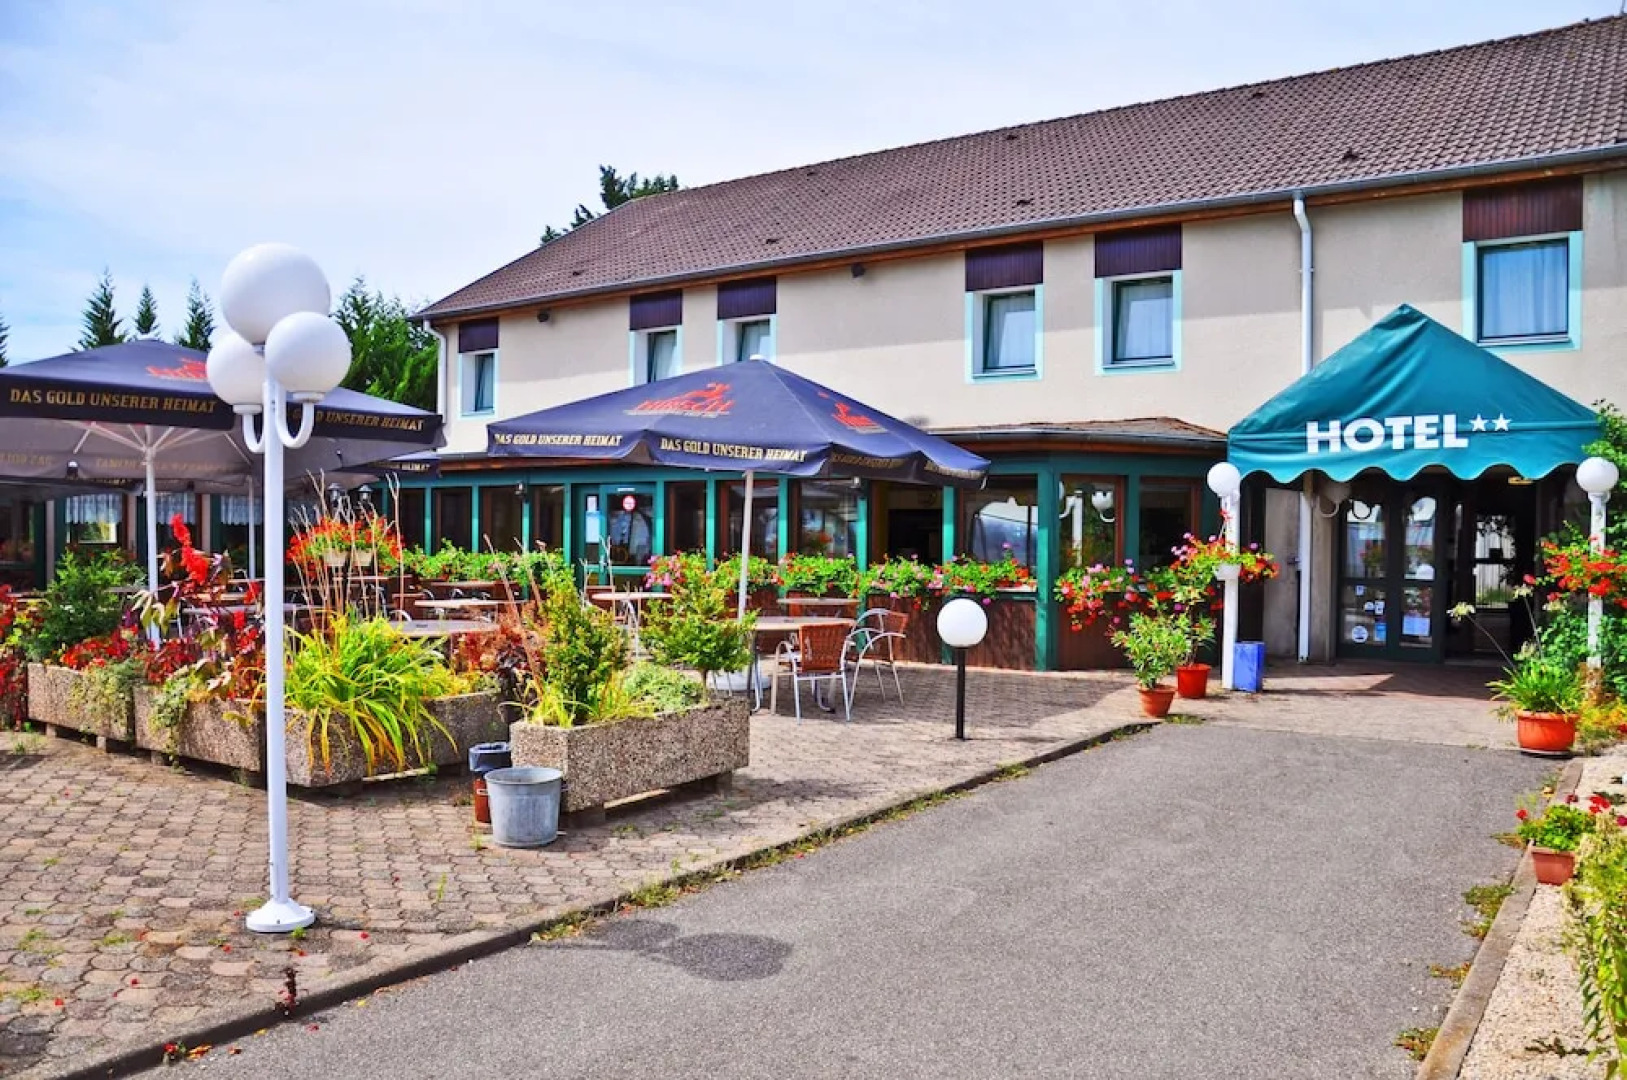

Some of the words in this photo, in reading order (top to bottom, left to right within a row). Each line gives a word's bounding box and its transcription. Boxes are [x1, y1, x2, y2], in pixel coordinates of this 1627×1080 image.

[10, 388, 42, 403] DAS
[46, 389, 86, 406] GOLD
[90, 393, 159, 410] UNSERER
[161, 397, 217, 413] HEIMAT
[513, 434, 538, 445] GOLD
[538, 434, 582, 445] UNSERER
[583, 435, 623, 446] HEIMAT
[1306, 414, 1468, 455] HOTEL
[660, 438, 681, 450] DAS
[683, 440, 710, 454] GOLD
[712, 443, 763, 460] UNSERER
[764, 448, 808, 462] HEIMAT
